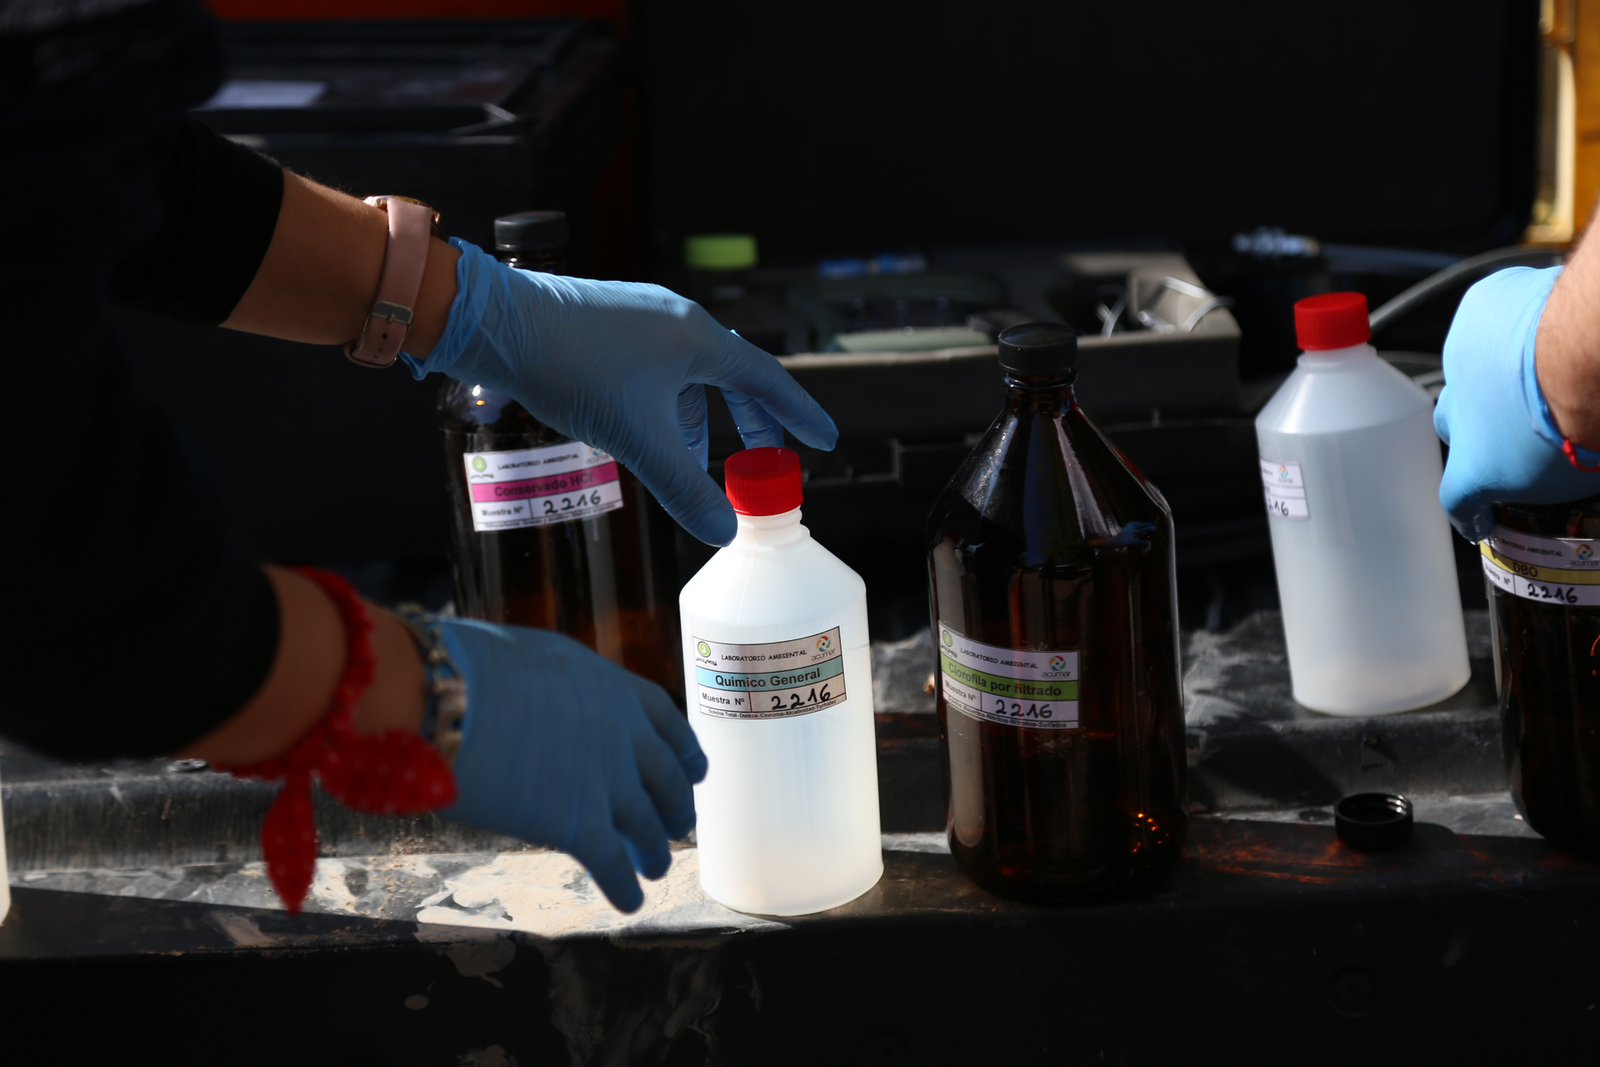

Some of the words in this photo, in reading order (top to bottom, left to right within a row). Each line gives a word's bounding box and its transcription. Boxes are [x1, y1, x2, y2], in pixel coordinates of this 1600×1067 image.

[494, 479, 568, 497] Conservado
[543, 489, 602, 515] 2216
[481, 508, 512, 517] Muestra
[1513, 562, 1538, 578] DBO
[1527, 583, 1578, 604] 2216
[721, 654, 766, 662] LABORATORIO
[768, 649, 808, 661] AMBIENTAL
[811, 647, 836, 662] acumar
[960, 647, 999, 665] LABORATORIO
[1000, 659, 1038, 670] AMBIENTAL
[715, 674, 767, 688] Quimico
[769, 667, 821, 687] General
[948, 662, 987, 688] Clorofila
[990, 681, 1011, 693] por
[1014, 682, 1062, 697] filtrado
[1041, 670, 1072, 679] acumar
[702, 692, 731, 706] Muestra
[734, 697, 745, 706] Nº
[770, 683, 831, 711] 2216
[945, 679, 967, 699] Muestra
[995, 698, 1053, 719] 2216
